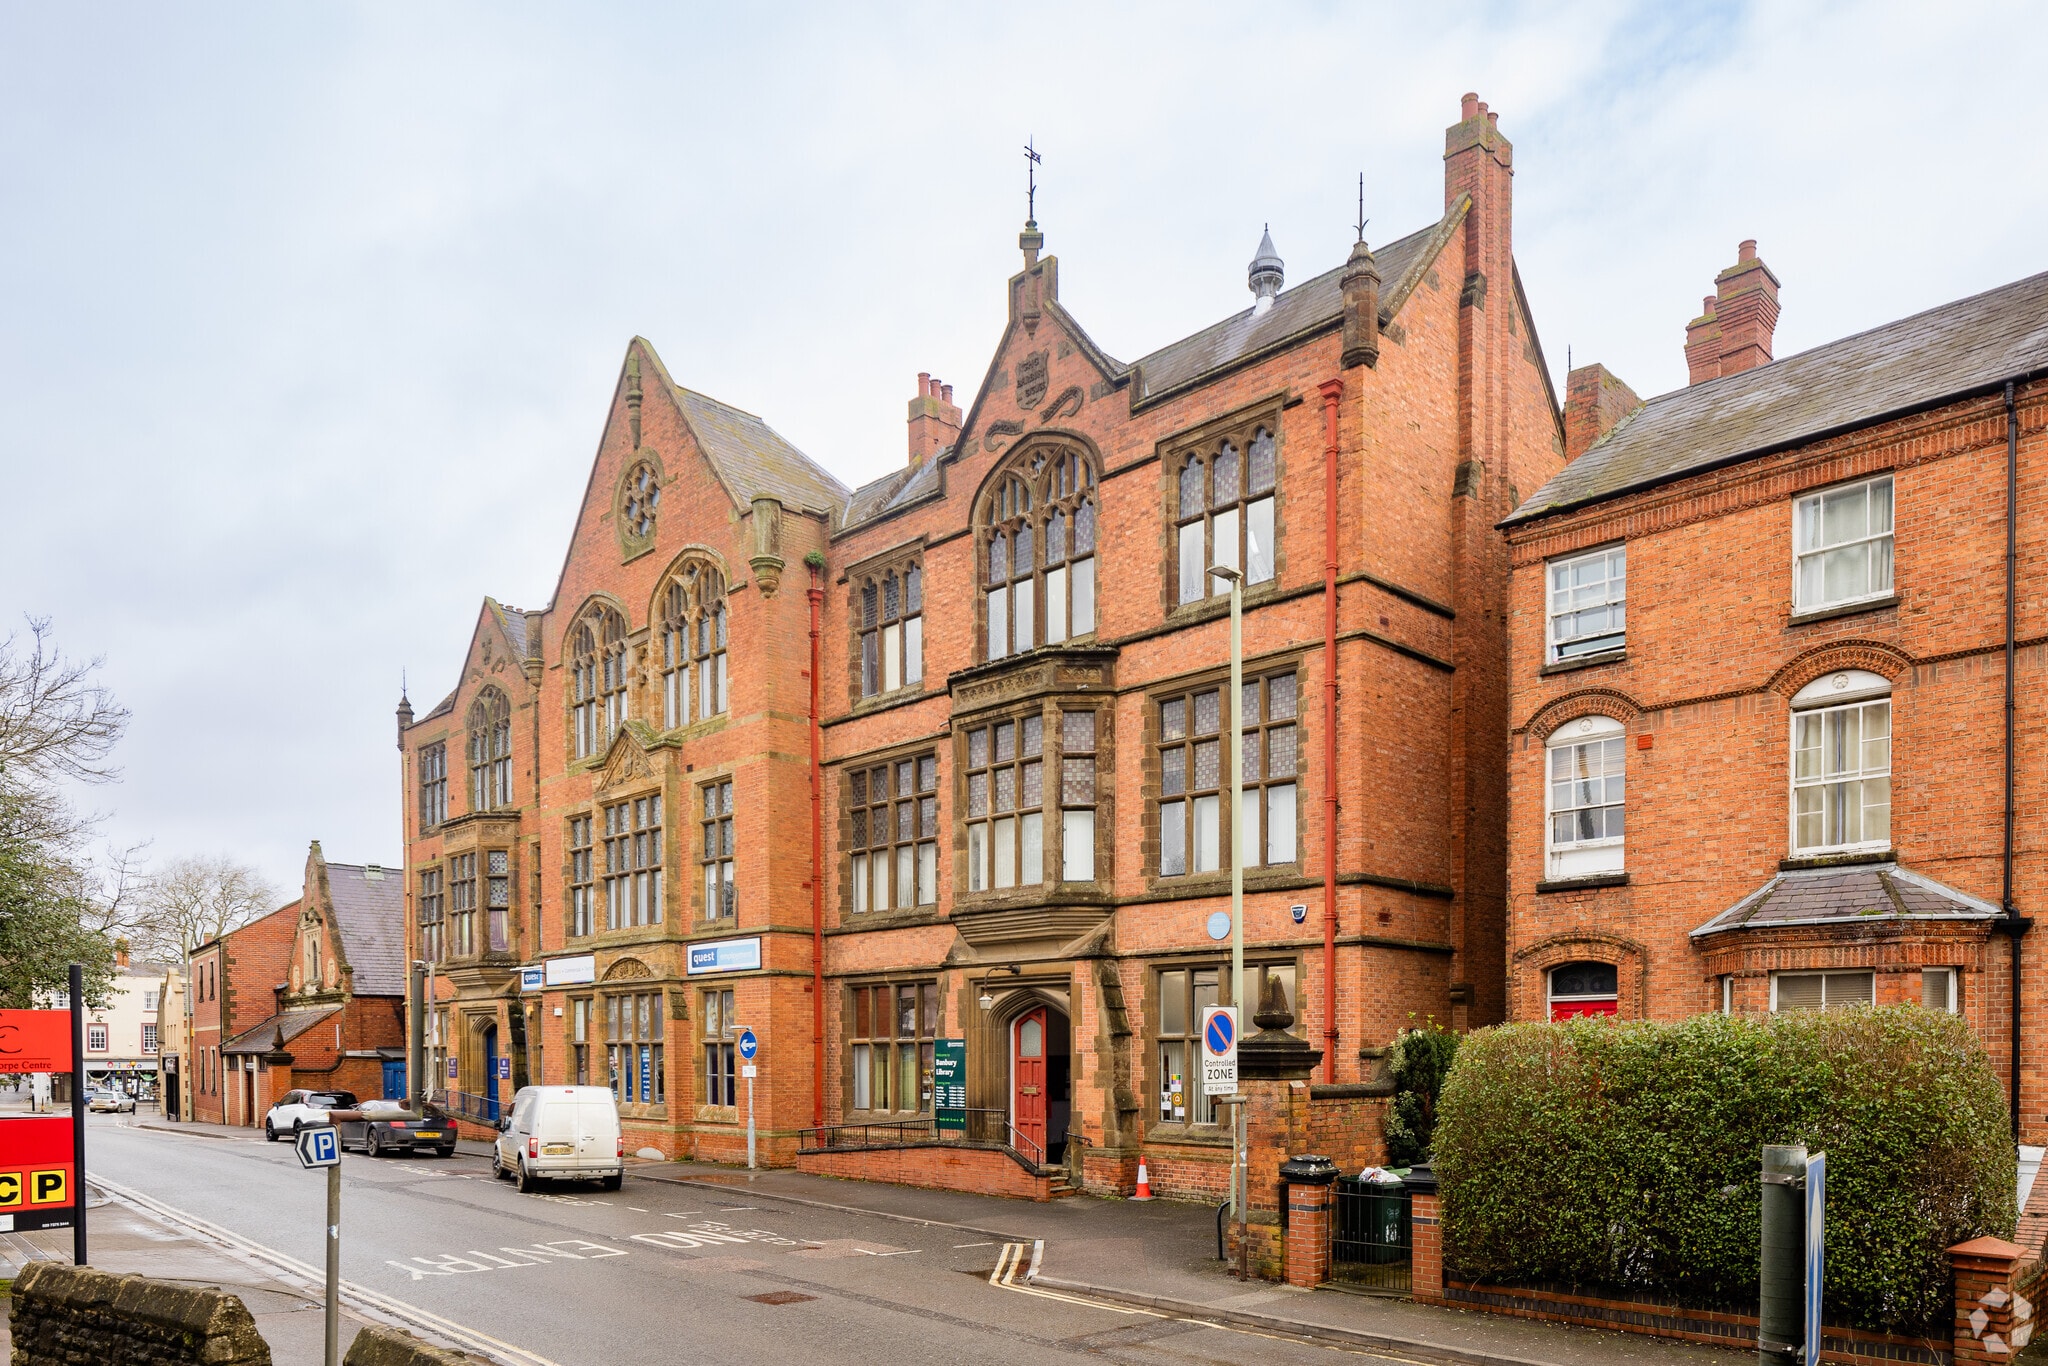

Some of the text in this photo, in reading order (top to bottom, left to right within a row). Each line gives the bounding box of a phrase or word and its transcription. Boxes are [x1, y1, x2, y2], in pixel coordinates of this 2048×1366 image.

[693, 952, 715, 965] quest
[524, 973, 539, 983] quest
[21, 1060, 52, 1070] Centre
[107, 1061, 142, 1069] Orinoo
[935, 1059, 957, 1068] Banbury
[1204, 1059, 1236, 1068] Controlled
[935, 1068, 954, 1078] Library
[1207, 1068, 1234, 1080] ZONE
[317, 1134, 333, 1159] P
[385, 1229, 751, 1281] NO ENTRY
